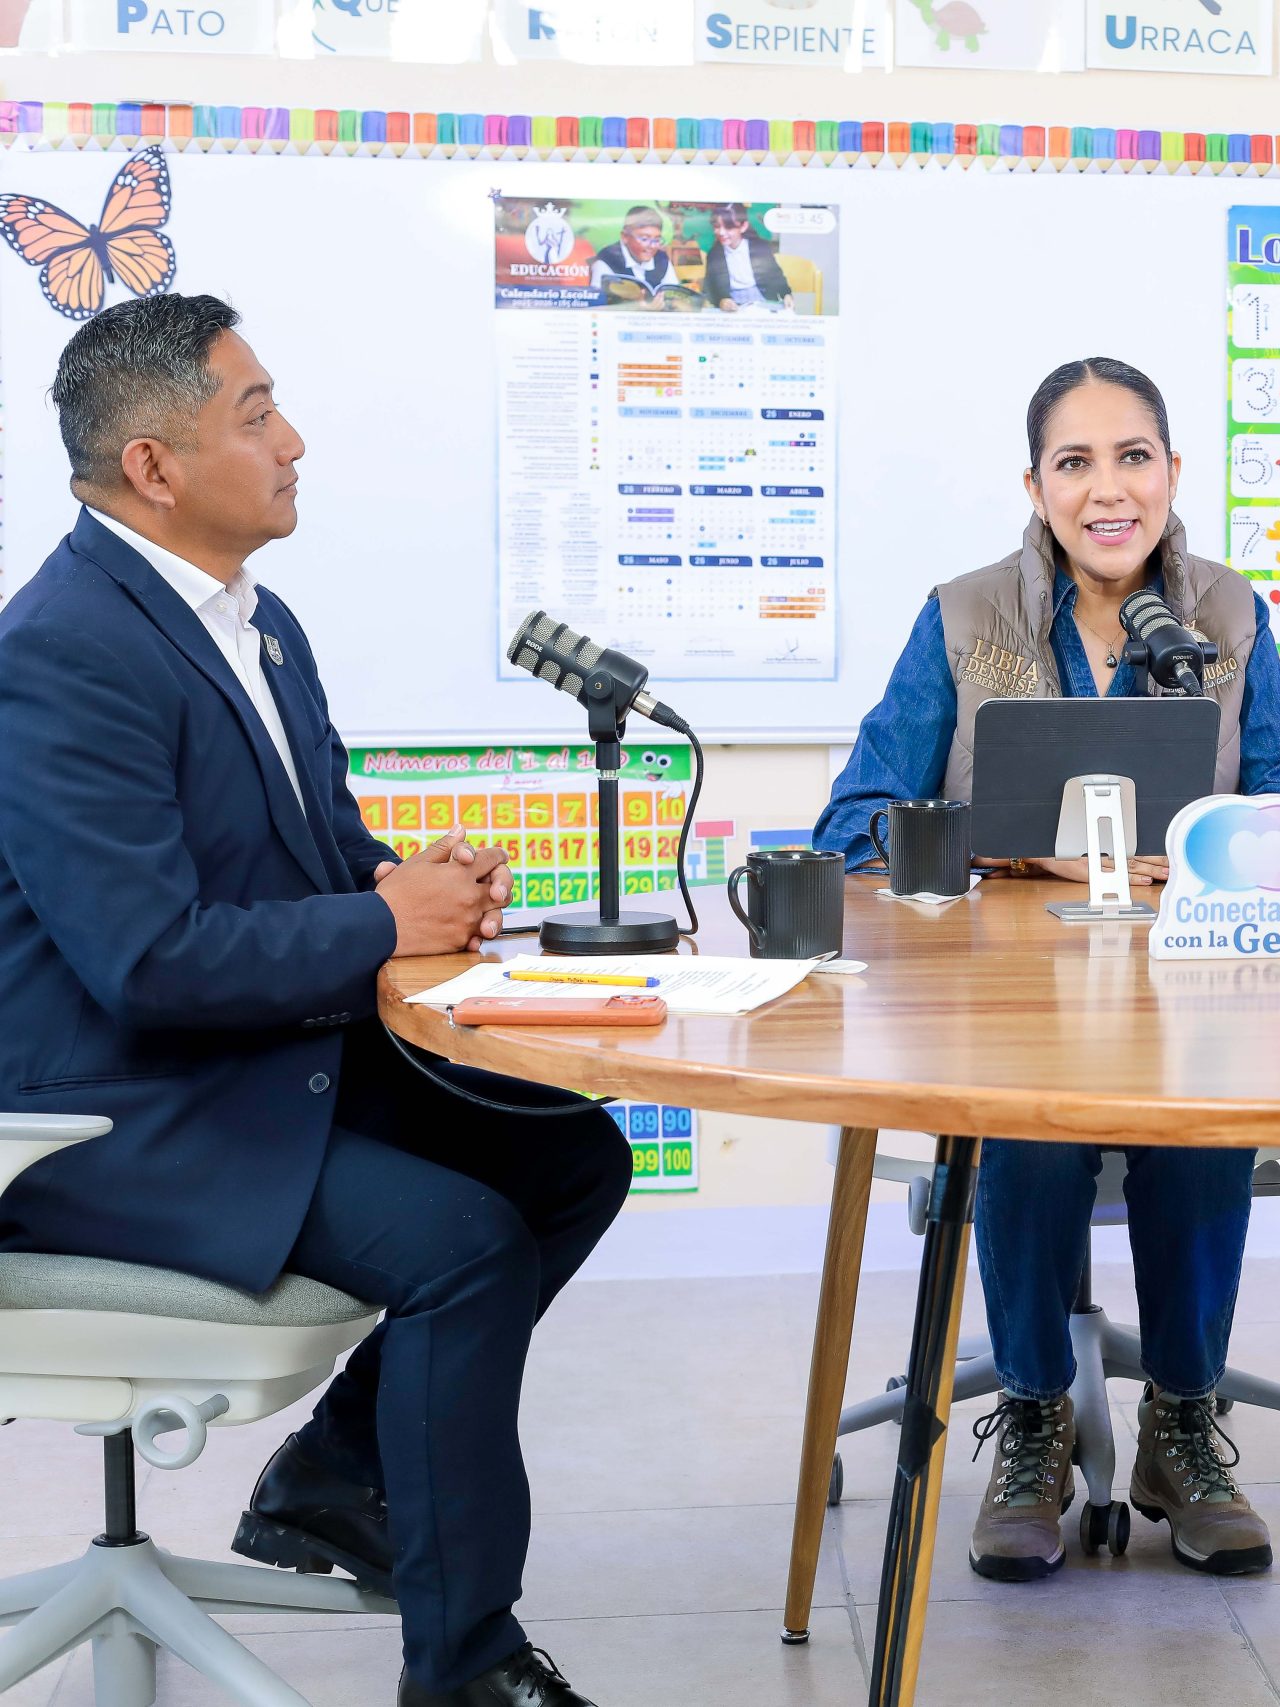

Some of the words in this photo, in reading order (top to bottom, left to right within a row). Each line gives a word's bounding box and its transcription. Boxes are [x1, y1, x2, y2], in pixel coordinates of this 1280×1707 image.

[117, 0, 225, 36] PATO
[706, 13, 875, 54] SERPIENTE
[1106, 15, 1256, 56] URRACA
[510, 263, 590, 277] EDUCACIÓN
[501, 287, 560, 299] Calendario
[561, 289, 601, 300] Escolar
[1248, 296, 1260, 341] 1
[1247, 372, 1272, 411] 3
[1239, 447, 1266, 485] 5
[1232, 521, 1260, 558] 7
[972, 638, 1039, 682] LIBIA
[965, 657, 1037, 695] DENNISE
[1216, 671, 1236, 685] GENTE
[364, 750, 470, 773] Números
[476, 747, 513, 771] del
[546, 746, 570, 770] al
[366, 803, 381, 827] 1
[397, 802, 418, 826] 2
[430, 801, 449, 826] 3
[462, 802, 483, 826] 4
[496, 802, 516, 825] 5
[529, 801, 549, 825] 6
[562, 800, 582, 823] 7
[628, 798, 648, 822] 9
[657, 798, 684, 821] 10
[527, 838, 553, 861] 16
[559, 837, 585, 860] 17
[625, 836, 651, 859] 19
[526, 878, 555, 902] 26
[559, 877, 587, 902] 27
[1164, 935, 1203, 948] con
[1208, 931, 1229, 948] la
[629, 1111, 658, 1133] 89
[663, 1109, 691, 1132] 90
[633, 1149, 658, 1172] 99
[664, 1148, 691, 1171] 100
